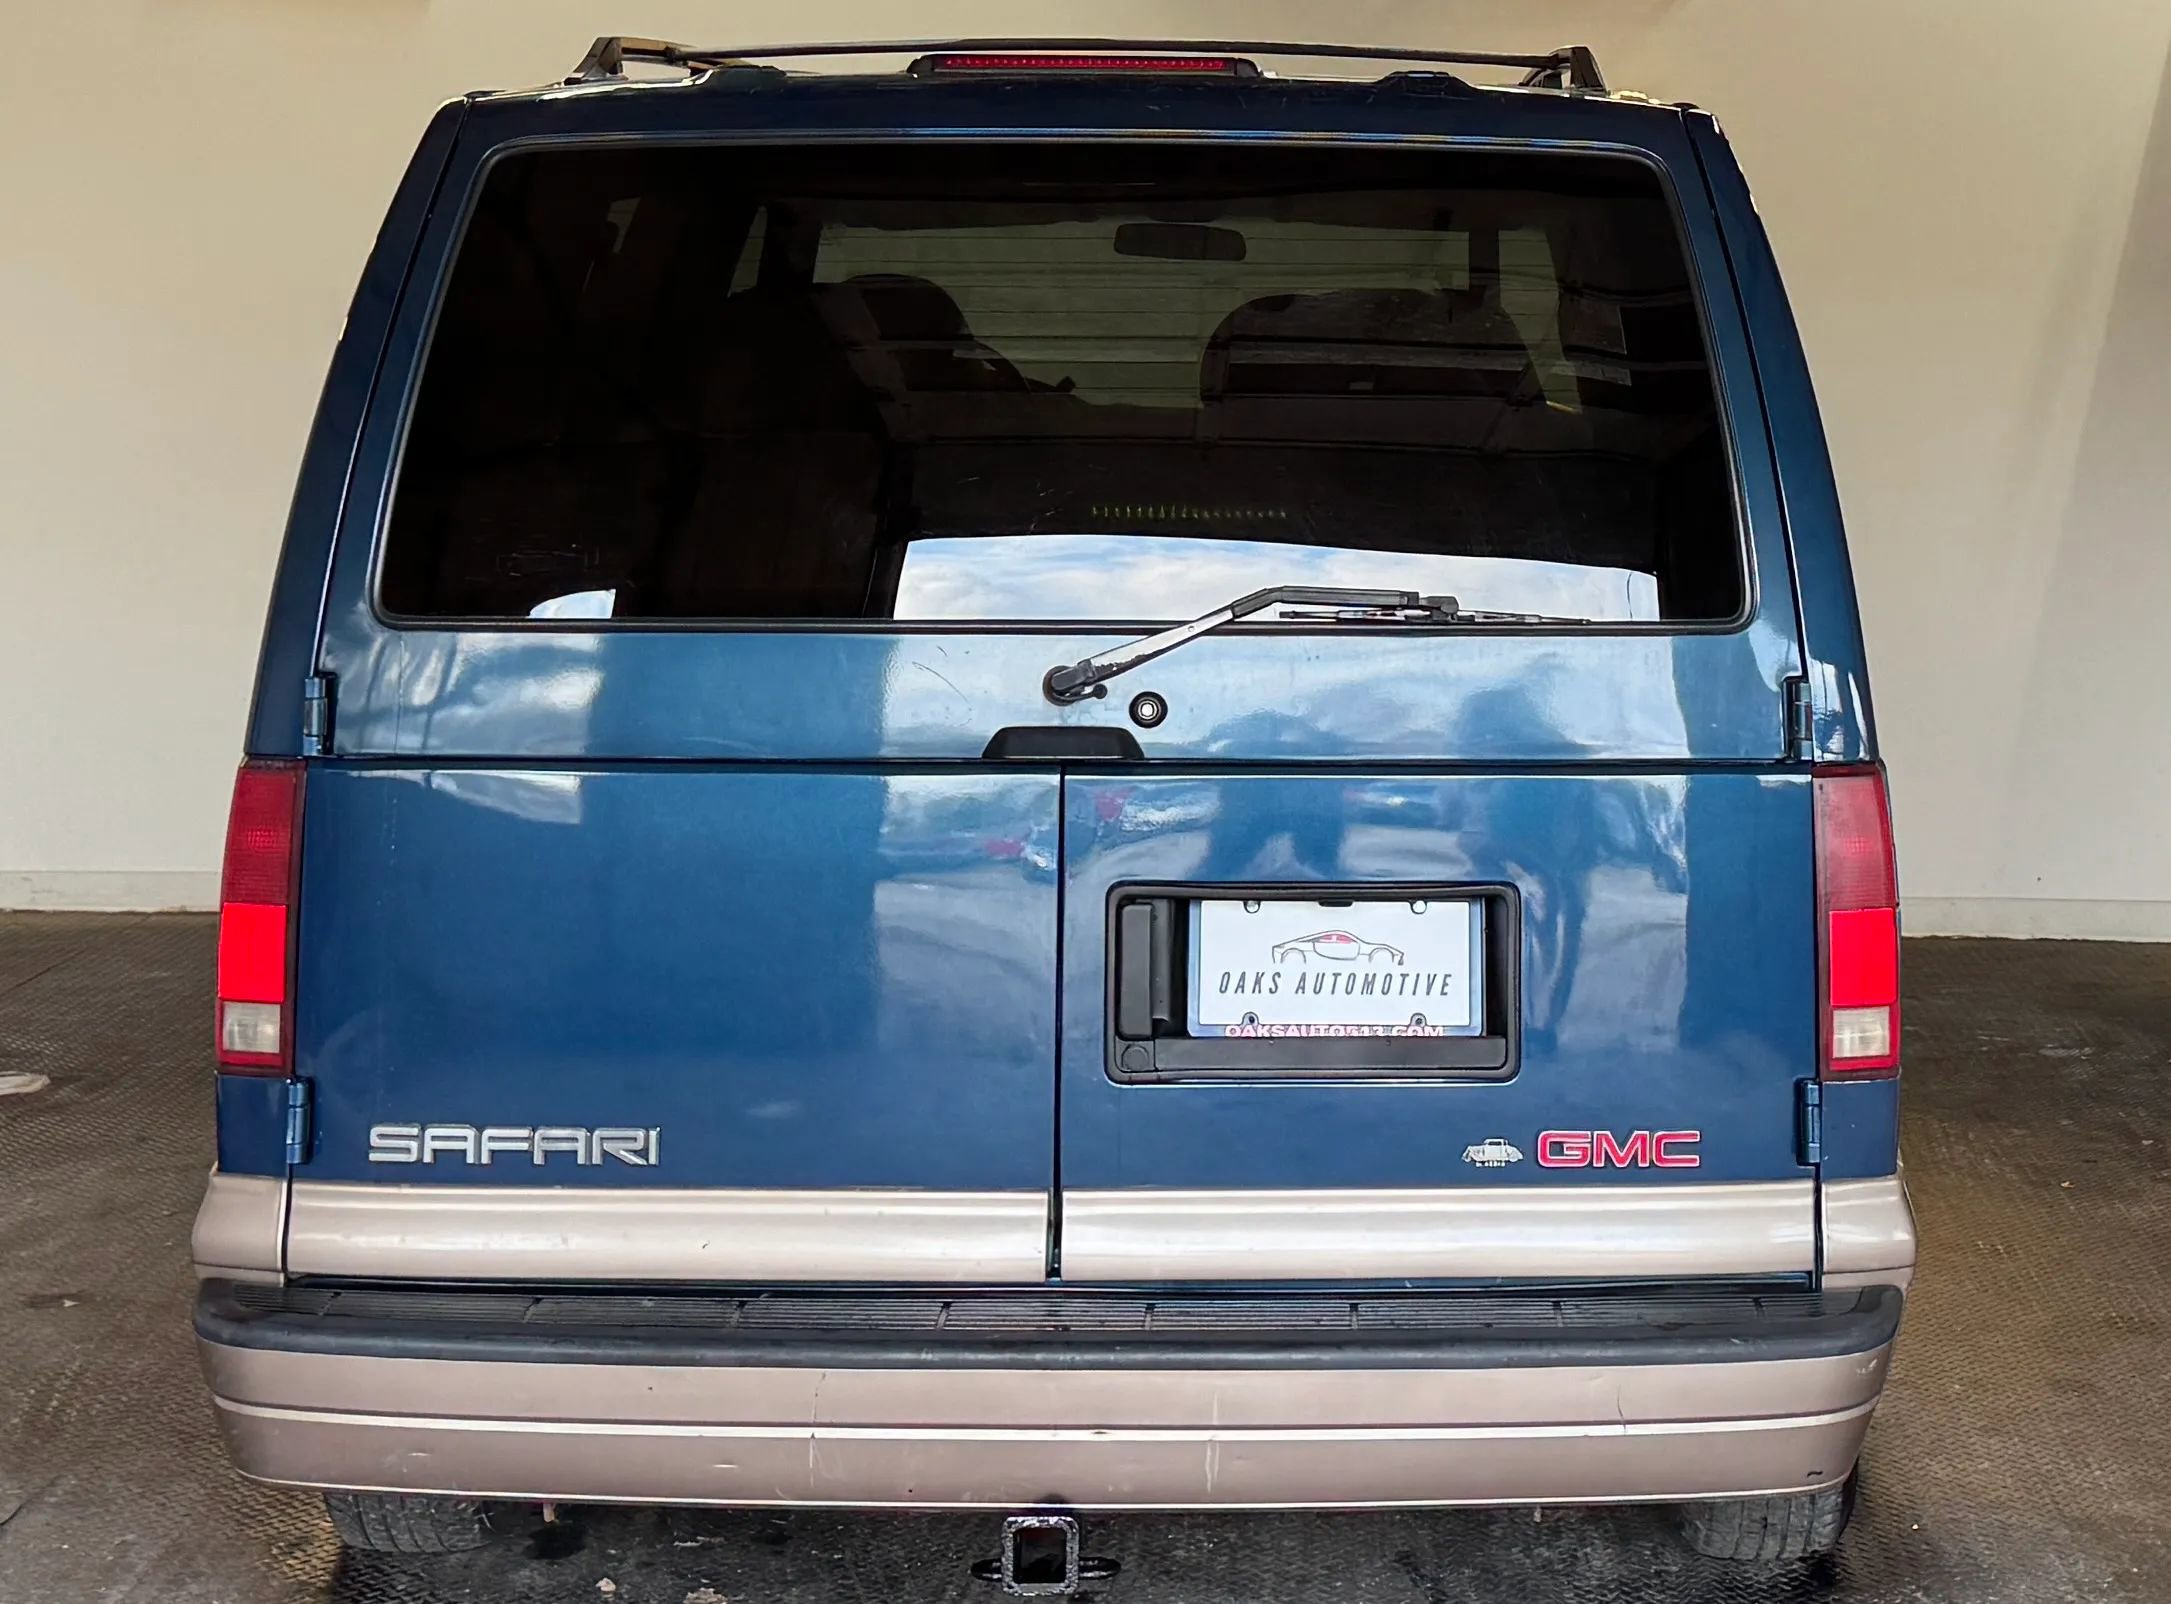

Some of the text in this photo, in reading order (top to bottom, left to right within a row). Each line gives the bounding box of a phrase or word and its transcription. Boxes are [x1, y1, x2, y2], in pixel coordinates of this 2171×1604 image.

[1218, 971, 1453, 996] OAKS AUTOMOTIVE
[368, 1123, 661, 1166] SAFARI
[1537, 1130, 1700, 1168] GMC
